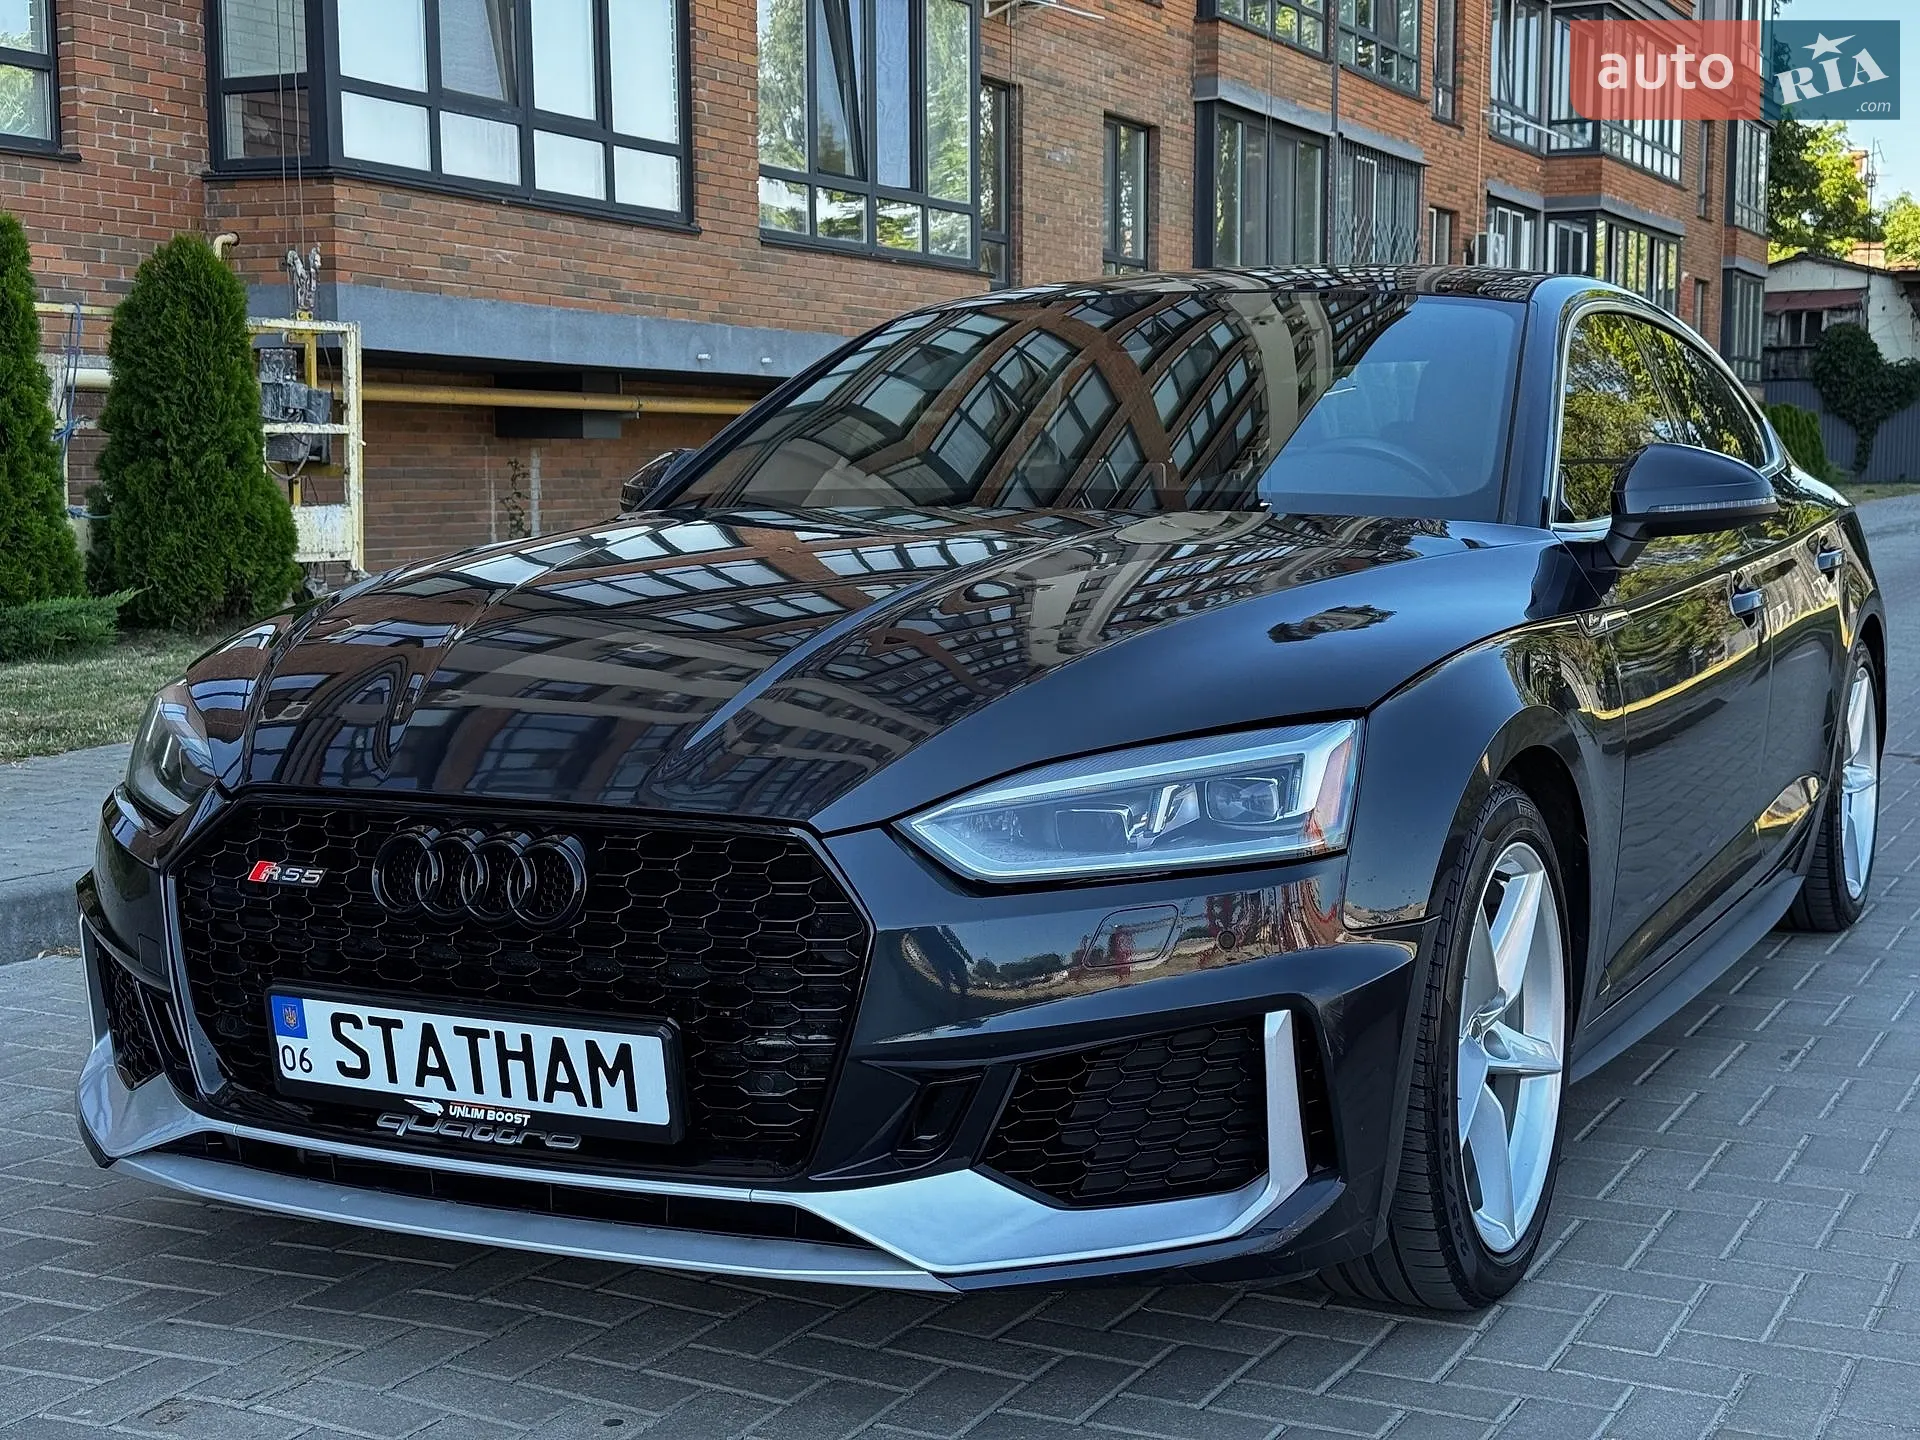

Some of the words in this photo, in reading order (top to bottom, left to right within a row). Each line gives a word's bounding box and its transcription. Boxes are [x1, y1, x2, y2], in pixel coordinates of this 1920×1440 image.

[254, 862, 325, 885] RS5
[281, 1043, 313, 1075] 06
[330, 1012, 639, 1113] STATHAM
[376, 1112, 582, 1150] quattro
[449, 1104, 485, 1119] UNLIM
[486, 1109, 531, 1127] BOOST
